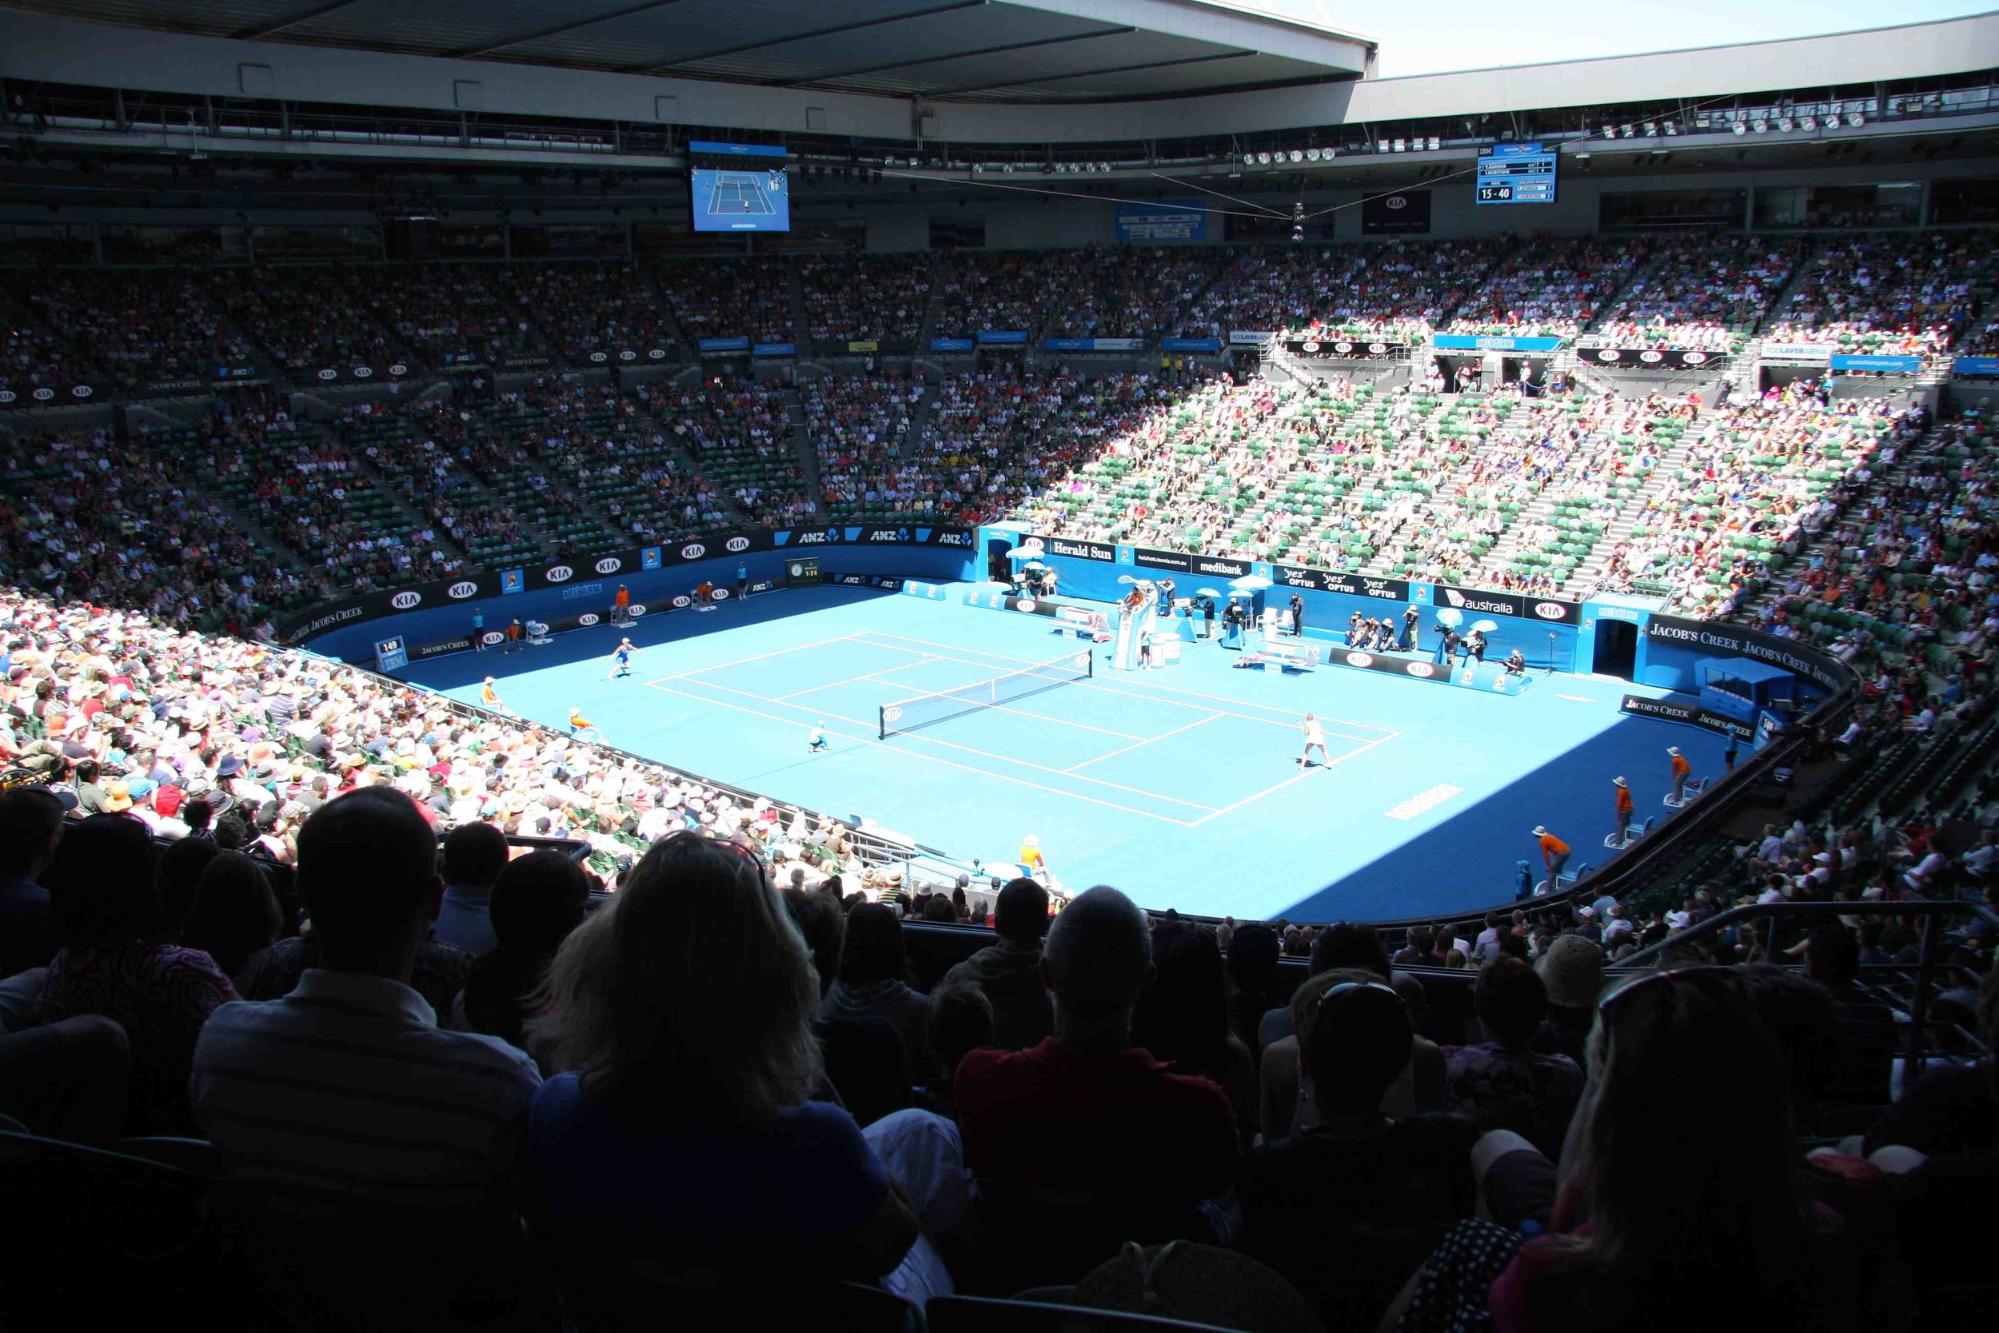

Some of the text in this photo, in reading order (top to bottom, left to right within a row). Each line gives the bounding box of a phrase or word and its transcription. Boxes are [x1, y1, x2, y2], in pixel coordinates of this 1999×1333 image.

[1481, 189, 1492, 200] 15
[1498, 188, 1510, 199] 40
[1388, 199, 1405, 209] KIA
[1305, 343, 1317, 351] KIA
[1337, 343, 1350, 351] KIA
[1371, 344, 1384, 352] KIA
[592, 353, 606, 361] KIA
[621, 351, 635, 359] KIA
[651, 349, 664, 358] KIA
[1601, 351, 1616, 360] KIA
[1642, 352, 1659, 361] KIA
[1685, 353, 1702, 363] KIA
[320, 370, 335, 379] KIA
[356, 367, 371, 377] KIA
[391, 365, 406, 375] KIA
[36, 390, 52, 399] KIA
[74, 387, 91, 396] KIA
[798, 532, 826, 544] ANZ
[870, 531, 897, 541] ANZ
[938, 533, 961, 545] ANZ
[729, 538, 747, 550] KIA
[684, 546, 703, 557] KIA
[1054, 541, 1112, 560] Herald Sun
[597, 559, 618, 572] KIA
[1200, 562, 1242, 576] medibank
[548, 567, 570, 580] KIA
[843, 576, 860, 584] ANZ
[880, 580, 895, 588] ANZ
[1289, 578, 1315, 588] OPTUS
[452, 583, 473, 597] KIA
[752, 582, 767, 592] ANZ
[1327, 583, 1355, 593] OPTUS
[713, 590, 728, 599] KIA
[1368, 588, 1396, 599] OPTUS
[396, 593, 418, 607] KIA
[674, 597, 689, 606] KIA
[630, 606, 644, 615] KIA
[1465, 599, 1513, 614] australia
[1539, 605, 1561, 616] KIA
[310, 613, 334, 632] JACOB'S
[335, 606, 363, 622] CREEK
[581, 615, 597, 624] KIA
[485, 633, 501, 643] KIA
[382, 640, 398, 652] 149
[447, 640, 470, 650] CREEK
[1650, 623, 1698, 642] JACOB'S
[1700, 631, 1740, 650] CREEK
[1743, 640, 1782, 663] JACOB'S
[1782, 652, 1810, 673] CREEK
[1410, 665, 1430, 675] KIA
[1625, 698, 1660, 713] JACOB'S
[1660, 705, 1689, 719] CREEK
[1698, 713, 1728, 728] JACOB'S
